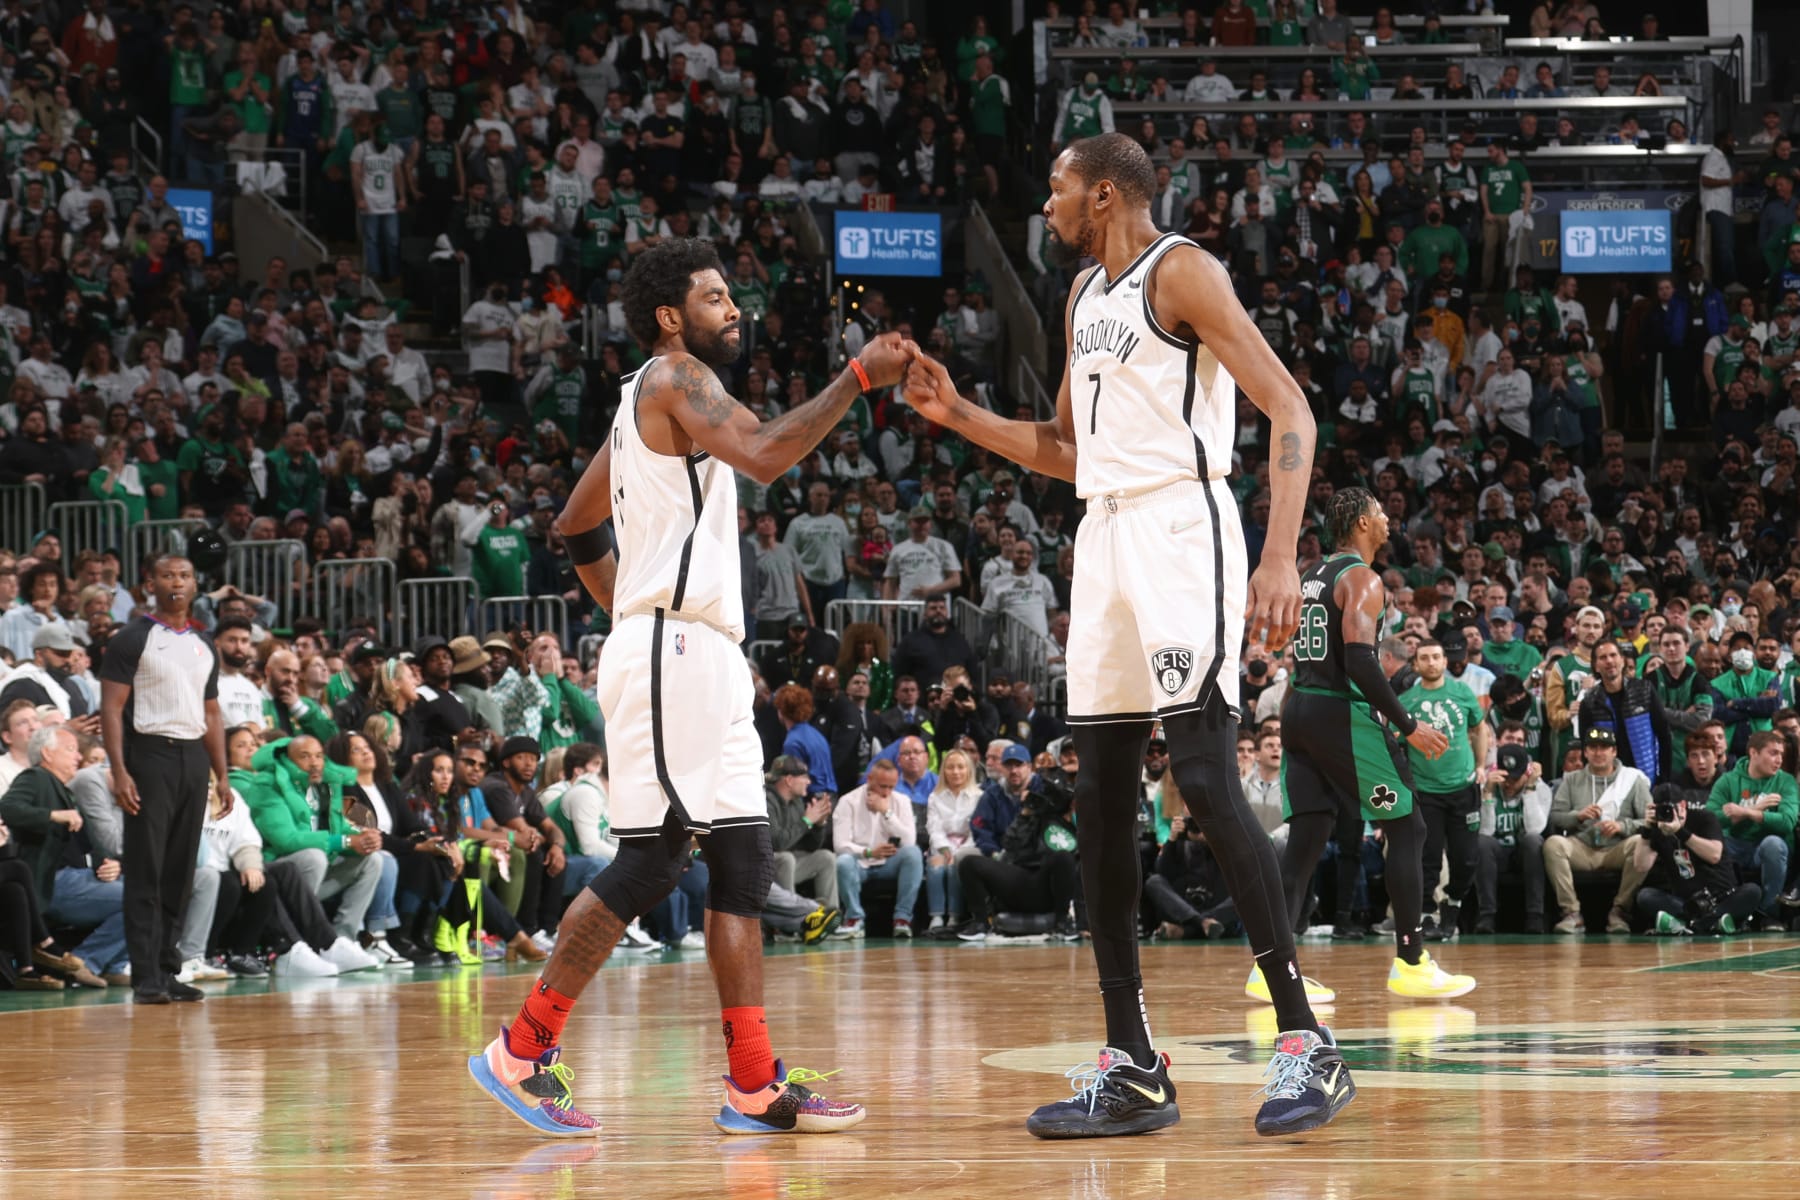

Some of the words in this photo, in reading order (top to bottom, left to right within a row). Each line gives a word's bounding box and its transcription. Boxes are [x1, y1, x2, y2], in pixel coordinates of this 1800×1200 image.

[1494, 182, 1505, 195] 7
[870, 223, 938, 243] TUFTS
[1598, 227, 1665, 243] TUFTS
[872, 244, 910, 259] Health
[912, 245, 938, 257] Plan
[1539, 239, 1557, 256] 17
[1599, 246, 1638, 259] Health
[1639, 246, 1665, 257] Plan
[1088, 373, 1101, 434] 7
[1293, 603, 1328, 662] 36
[1153, 651, 1190, 673] NETS
